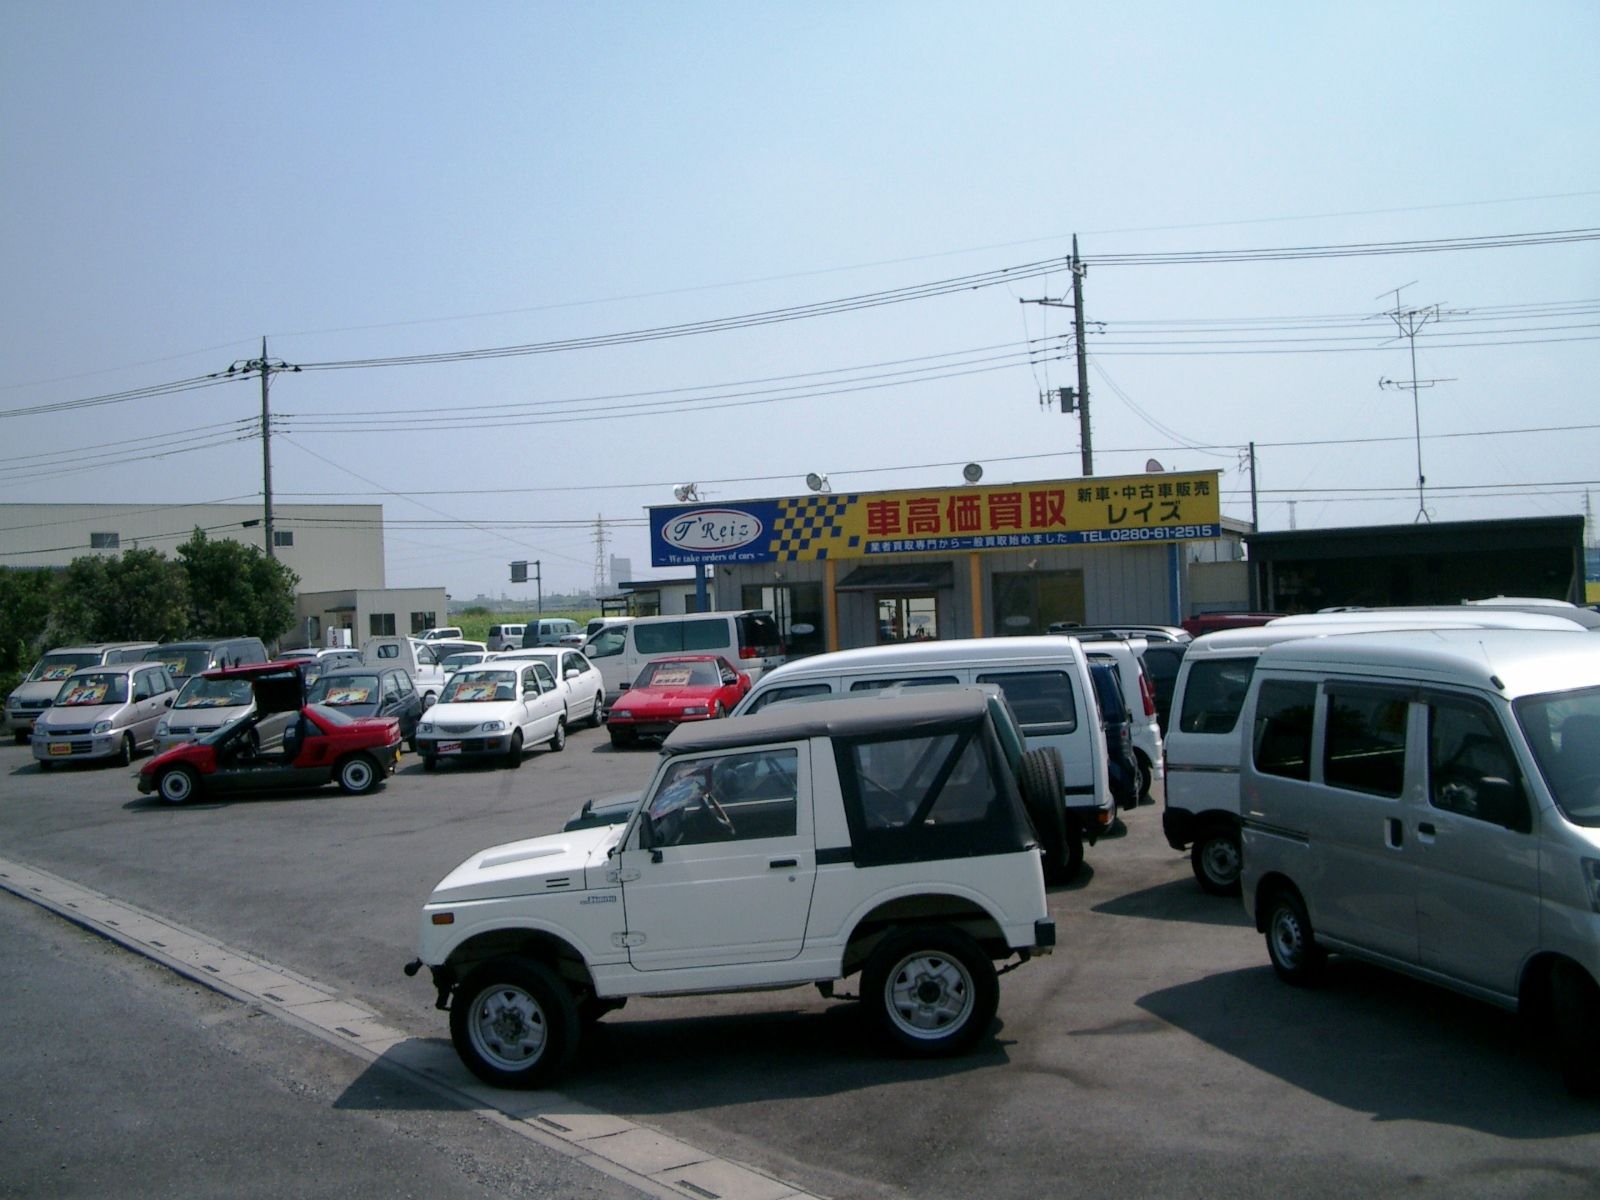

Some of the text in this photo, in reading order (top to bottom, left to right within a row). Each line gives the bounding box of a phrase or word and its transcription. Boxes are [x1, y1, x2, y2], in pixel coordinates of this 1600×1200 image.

[1077, 480, 1211, 502] 新車・中古車販売
[866, 489, 1067, 536] 車高価買取
[1107, 500, 1182, 525] レイズ
[1080, 524, 1213, 543] TEL.0280-61-2515
[669, 551, 755, 563] We take orders of cars
